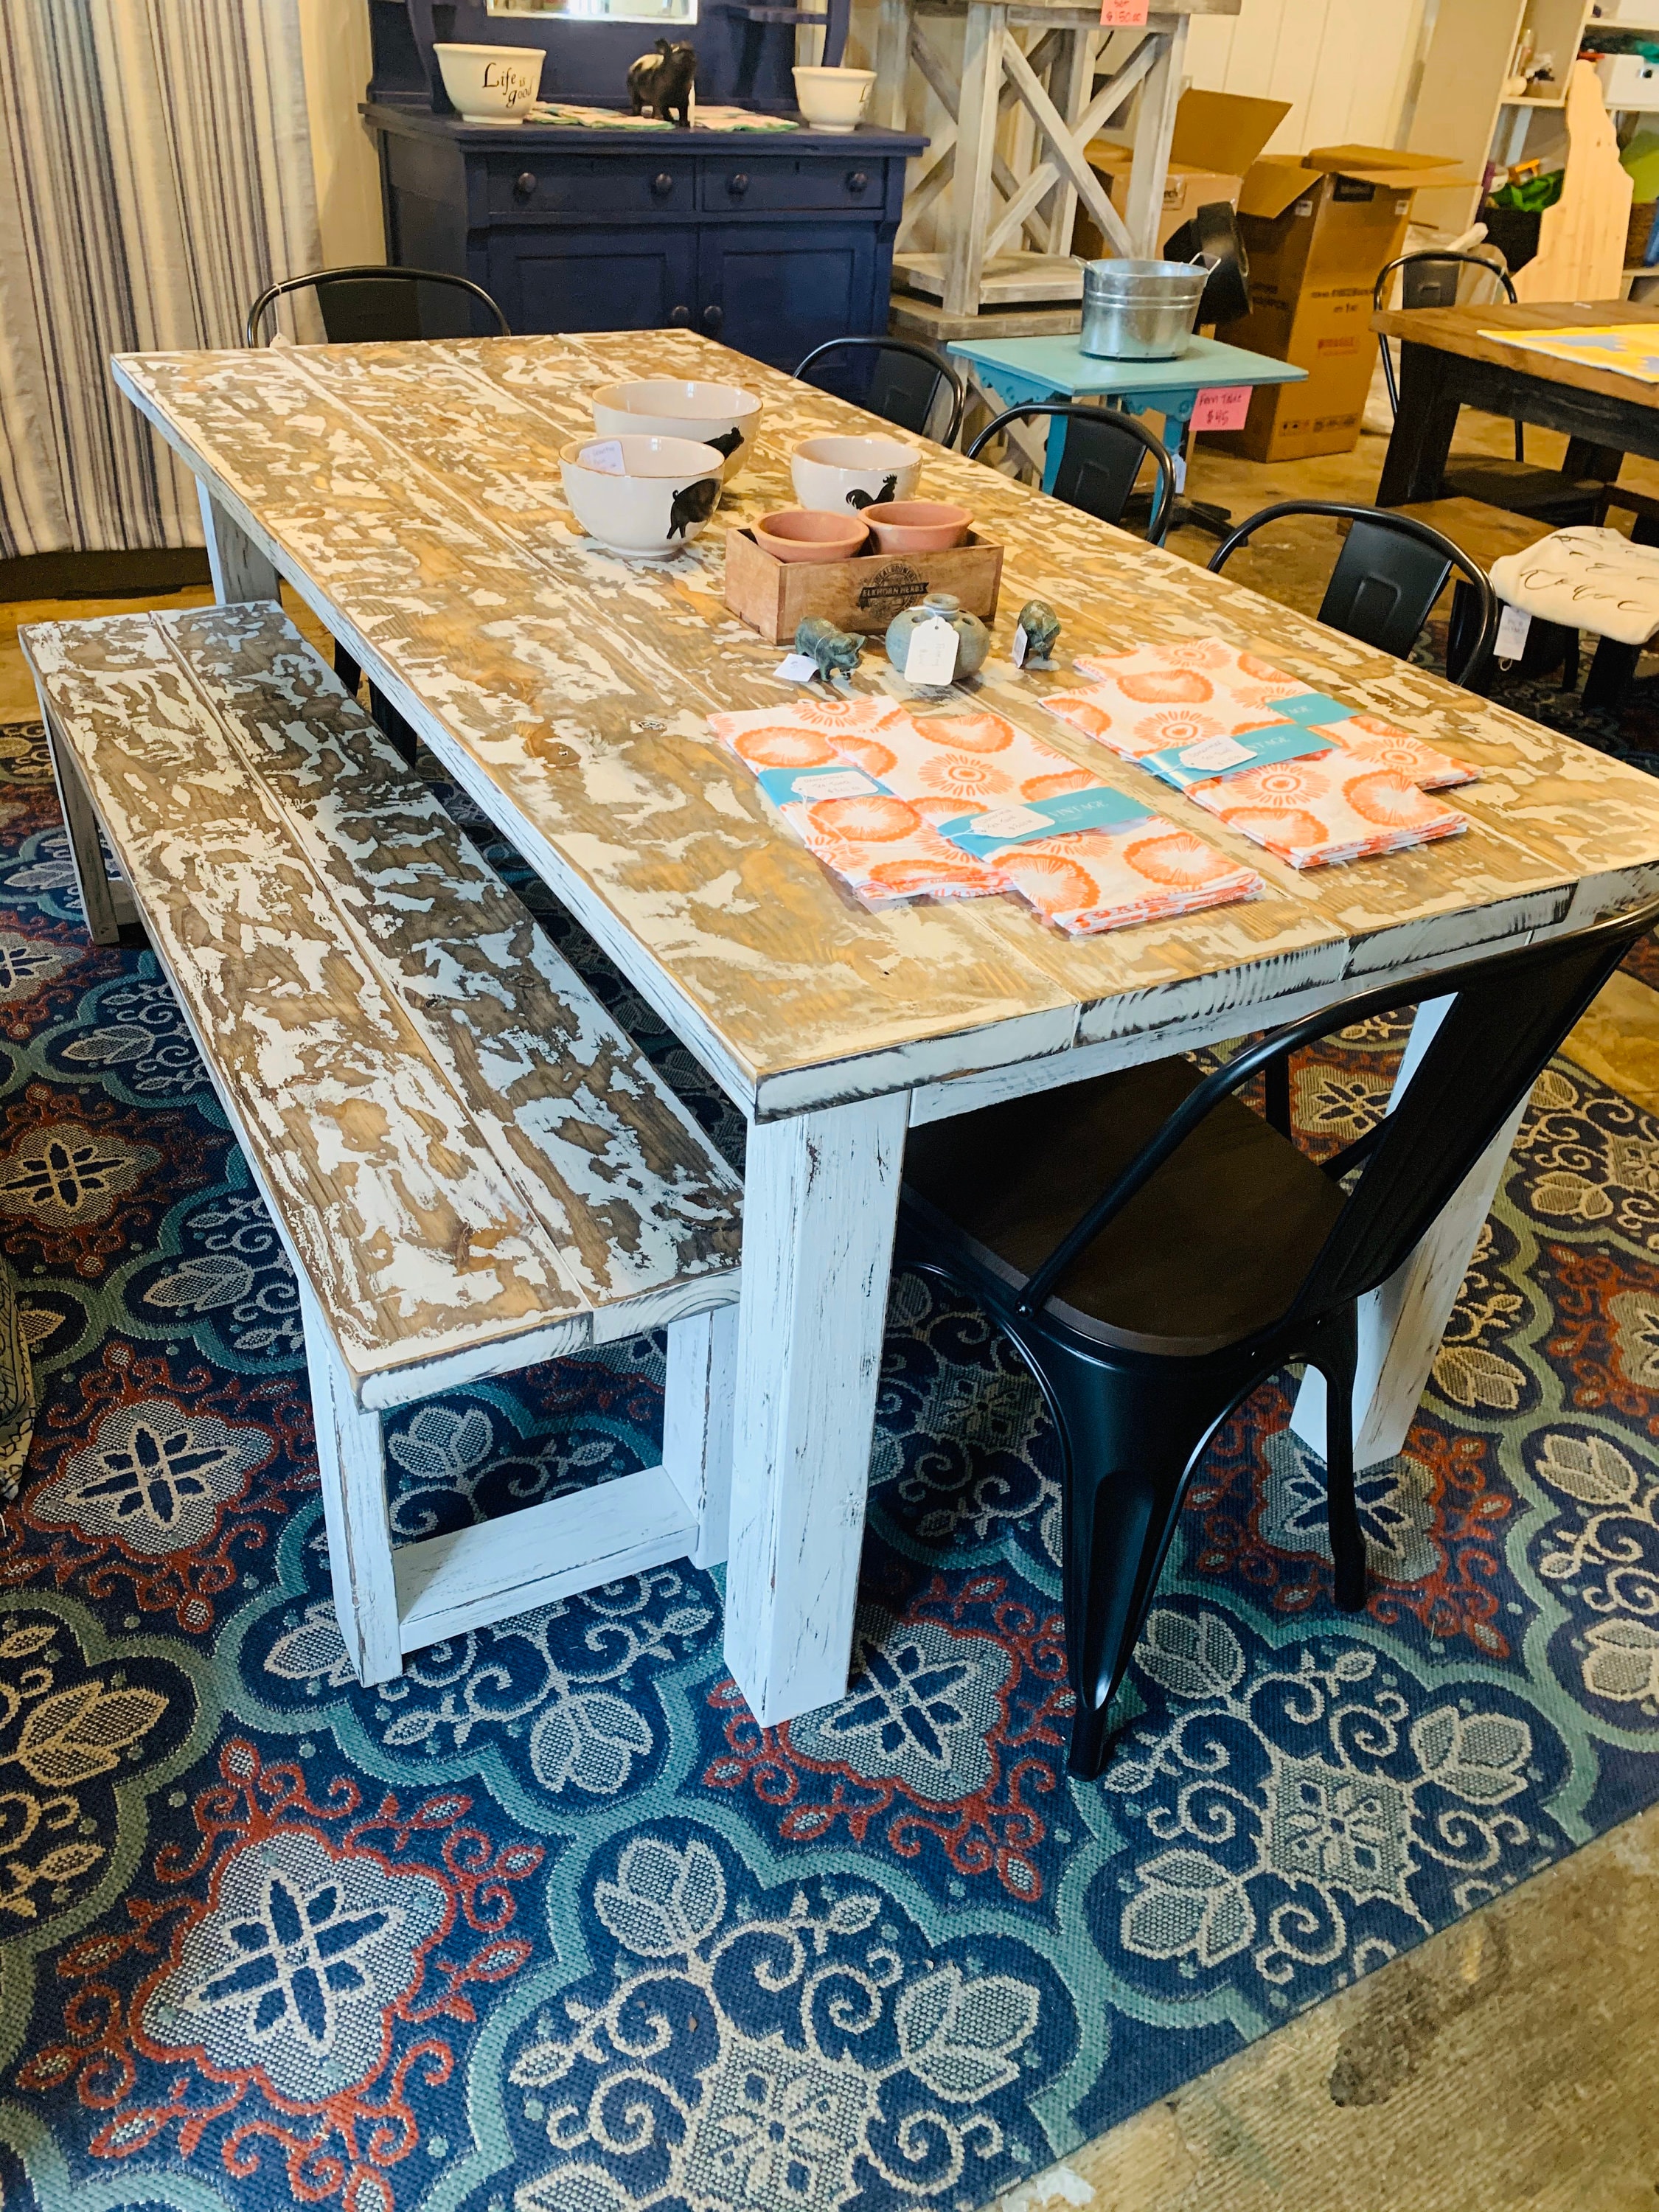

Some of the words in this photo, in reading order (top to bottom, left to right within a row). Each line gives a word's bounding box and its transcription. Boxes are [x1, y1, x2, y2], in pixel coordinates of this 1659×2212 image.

[481, 62, 517, 96] Life
[519, 77, 526, 87] is
[506, 75, 534, 108] good
[862, 587, 899, 597] ELKHORN
[900, 582, 925, 594] HERBS
